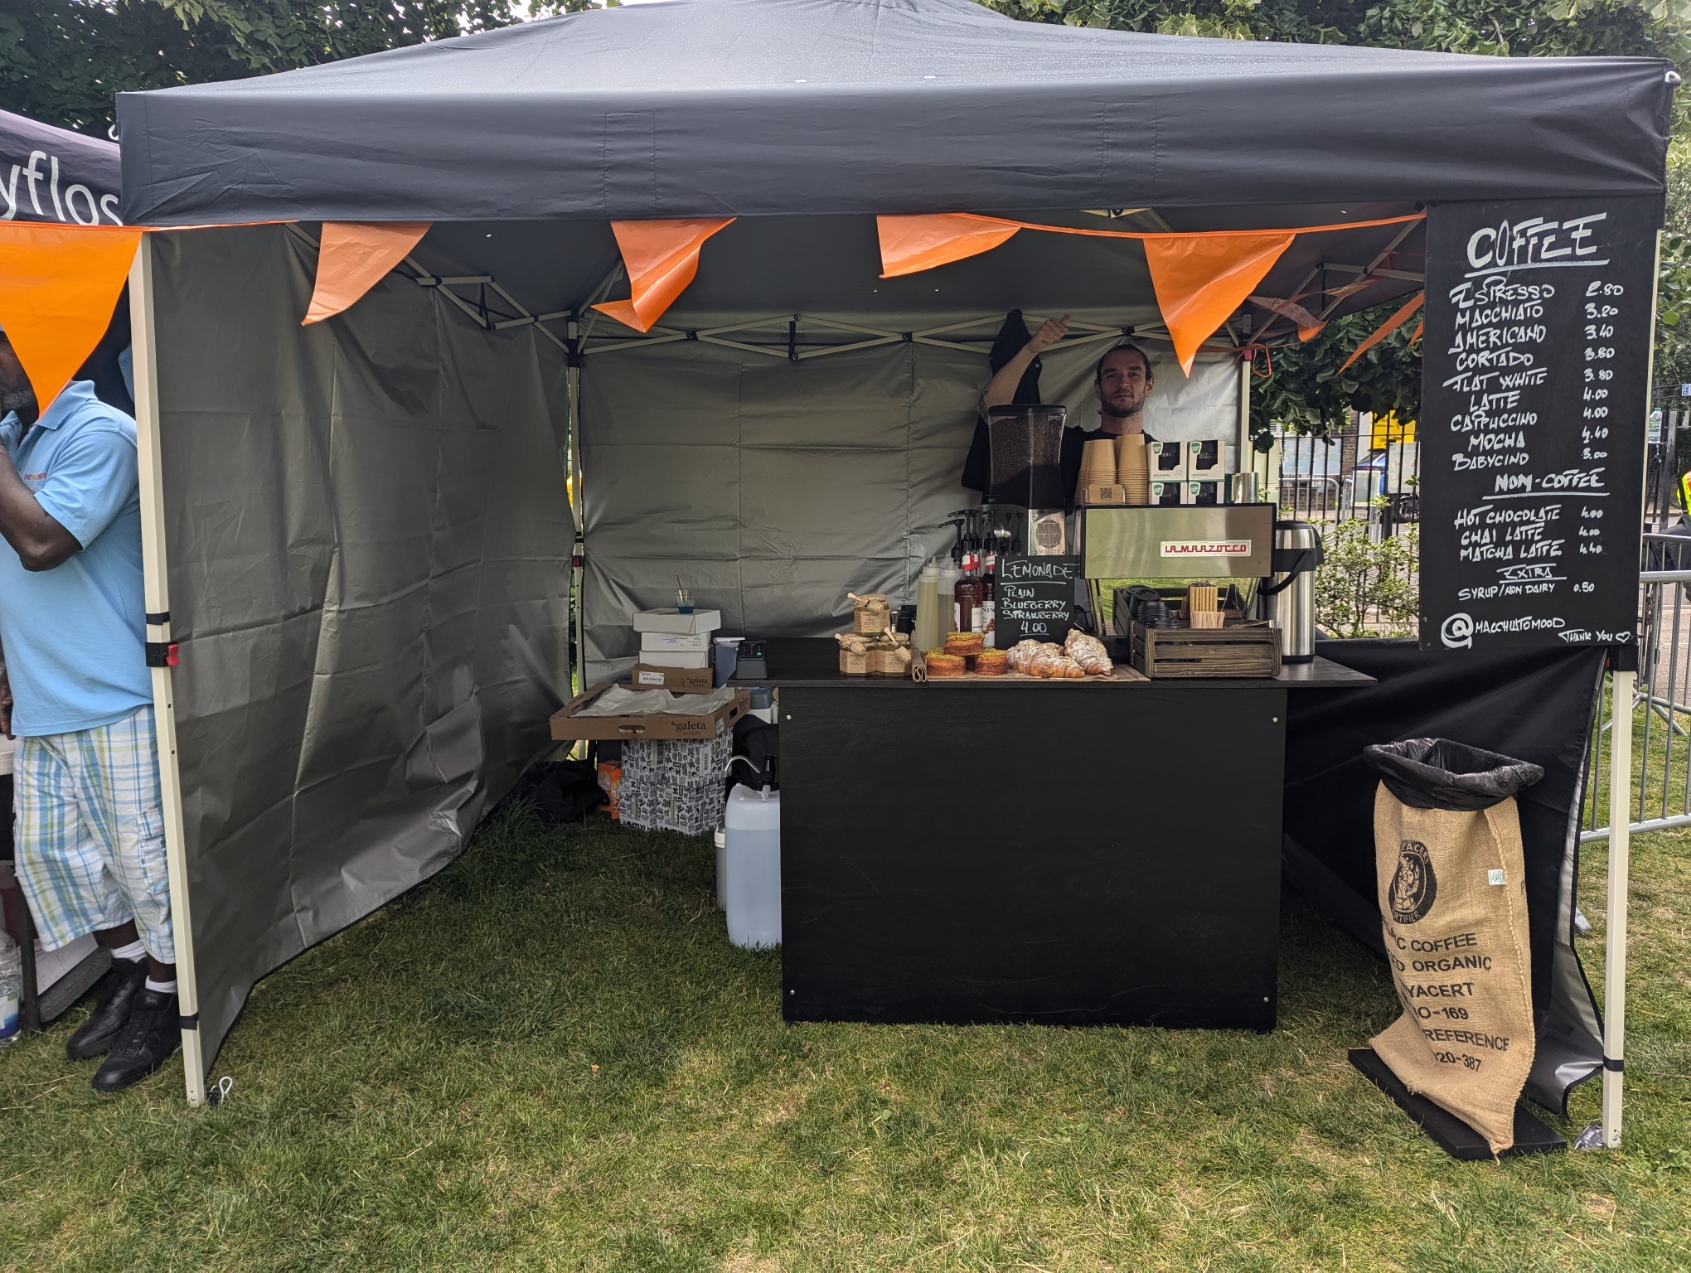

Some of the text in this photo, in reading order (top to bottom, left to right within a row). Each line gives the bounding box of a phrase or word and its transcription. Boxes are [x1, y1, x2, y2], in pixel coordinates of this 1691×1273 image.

[1467, 212, 1607, 268] COFFEE
[1449, 276, 1624, 308] ESPRESSO 2.80
[1455, 300, 1618, 330] MACCHIATO 3.20
[1448, 323, 1614, 354] AMERICANO 3.40
[1456, 347, 1615, 371] CORTADO 3.80
[1443, 372, 1500, 392] FLAT
[1499, 367, 1547, 389] WHITE
[1470, 386, 1609, 412] LATTE 4.00
[1450, 406, 1609, 432] CAPPUCCINO 4.00
[1468, 430, 1526, 452] MOCHA
[1451, 452, 1529, 471] BABYCINO
[1494, 467, 1605, 493] NON-COFFEE
[1454, 504, 1604, 530] HOT CHOCOLATE 4.00
[1461, 522, 1600, 545] CHAI LATTE 4.00
[1165, 545, 1177, 553] LA
[1460, 543, 1513, 562] MATCHA
[1520, 539, 1565, 558] LATTE
[1001, 558, 1080, 579] LEMONADE
[1496, 563, 1557, 579] EXTRA
[1004, 585, 1035, 598] PLAIN
[1525, 583, 1556, 594] DAIRY
[1573, 582, 1595, 593] 0.50
[1001, 598, 1066, 611] BLUEBERRY
[1002, 610, 1070, 621] STRAWBERRY
[1020, 620, 1047, 633] 4.00
[675, 720, 707, 733] galeta
[1402, 843, 1430, 864] YACERT
[1394, 911, 1421, 923] RTIFIER
[1410, 932, 1478, 953] COFFEE
[1412, 955, 1493, 972] ORGANIC
[1405, 982, 1475, 999] YACERT
[1424, 1028, 1510, 1052] REFERENCE
[1435, 1051, 1483, 1073] 20-387
